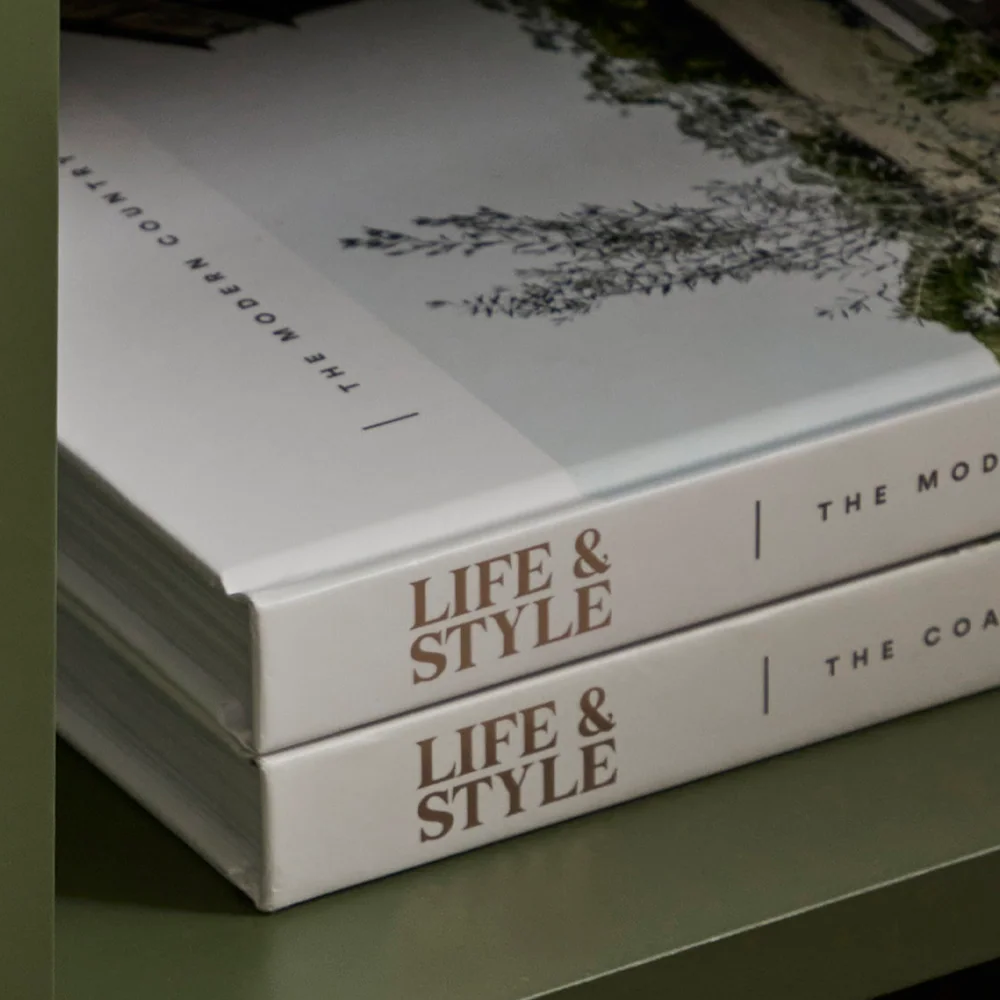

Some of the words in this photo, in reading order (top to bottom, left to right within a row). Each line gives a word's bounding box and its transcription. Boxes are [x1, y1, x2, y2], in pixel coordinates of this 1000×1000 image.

[184, 256, 300, 342] MODERN
[303, 352, 361, 393] THE
[817, 484, 888, 522] THE
[917, 452, 999, 493] MOD
[408, 541, 553, 631] LIFE
[573, 527, 612, 580] &
[409, 579, 613, 685] STYLE
[825, 640, 895, 677] THE
[923, 608, 1000, 647] COA
[415, 700, 558, 790] LIFE
[577, 686, 617, 738] &
[416, 737, 618, 843] STYLE
